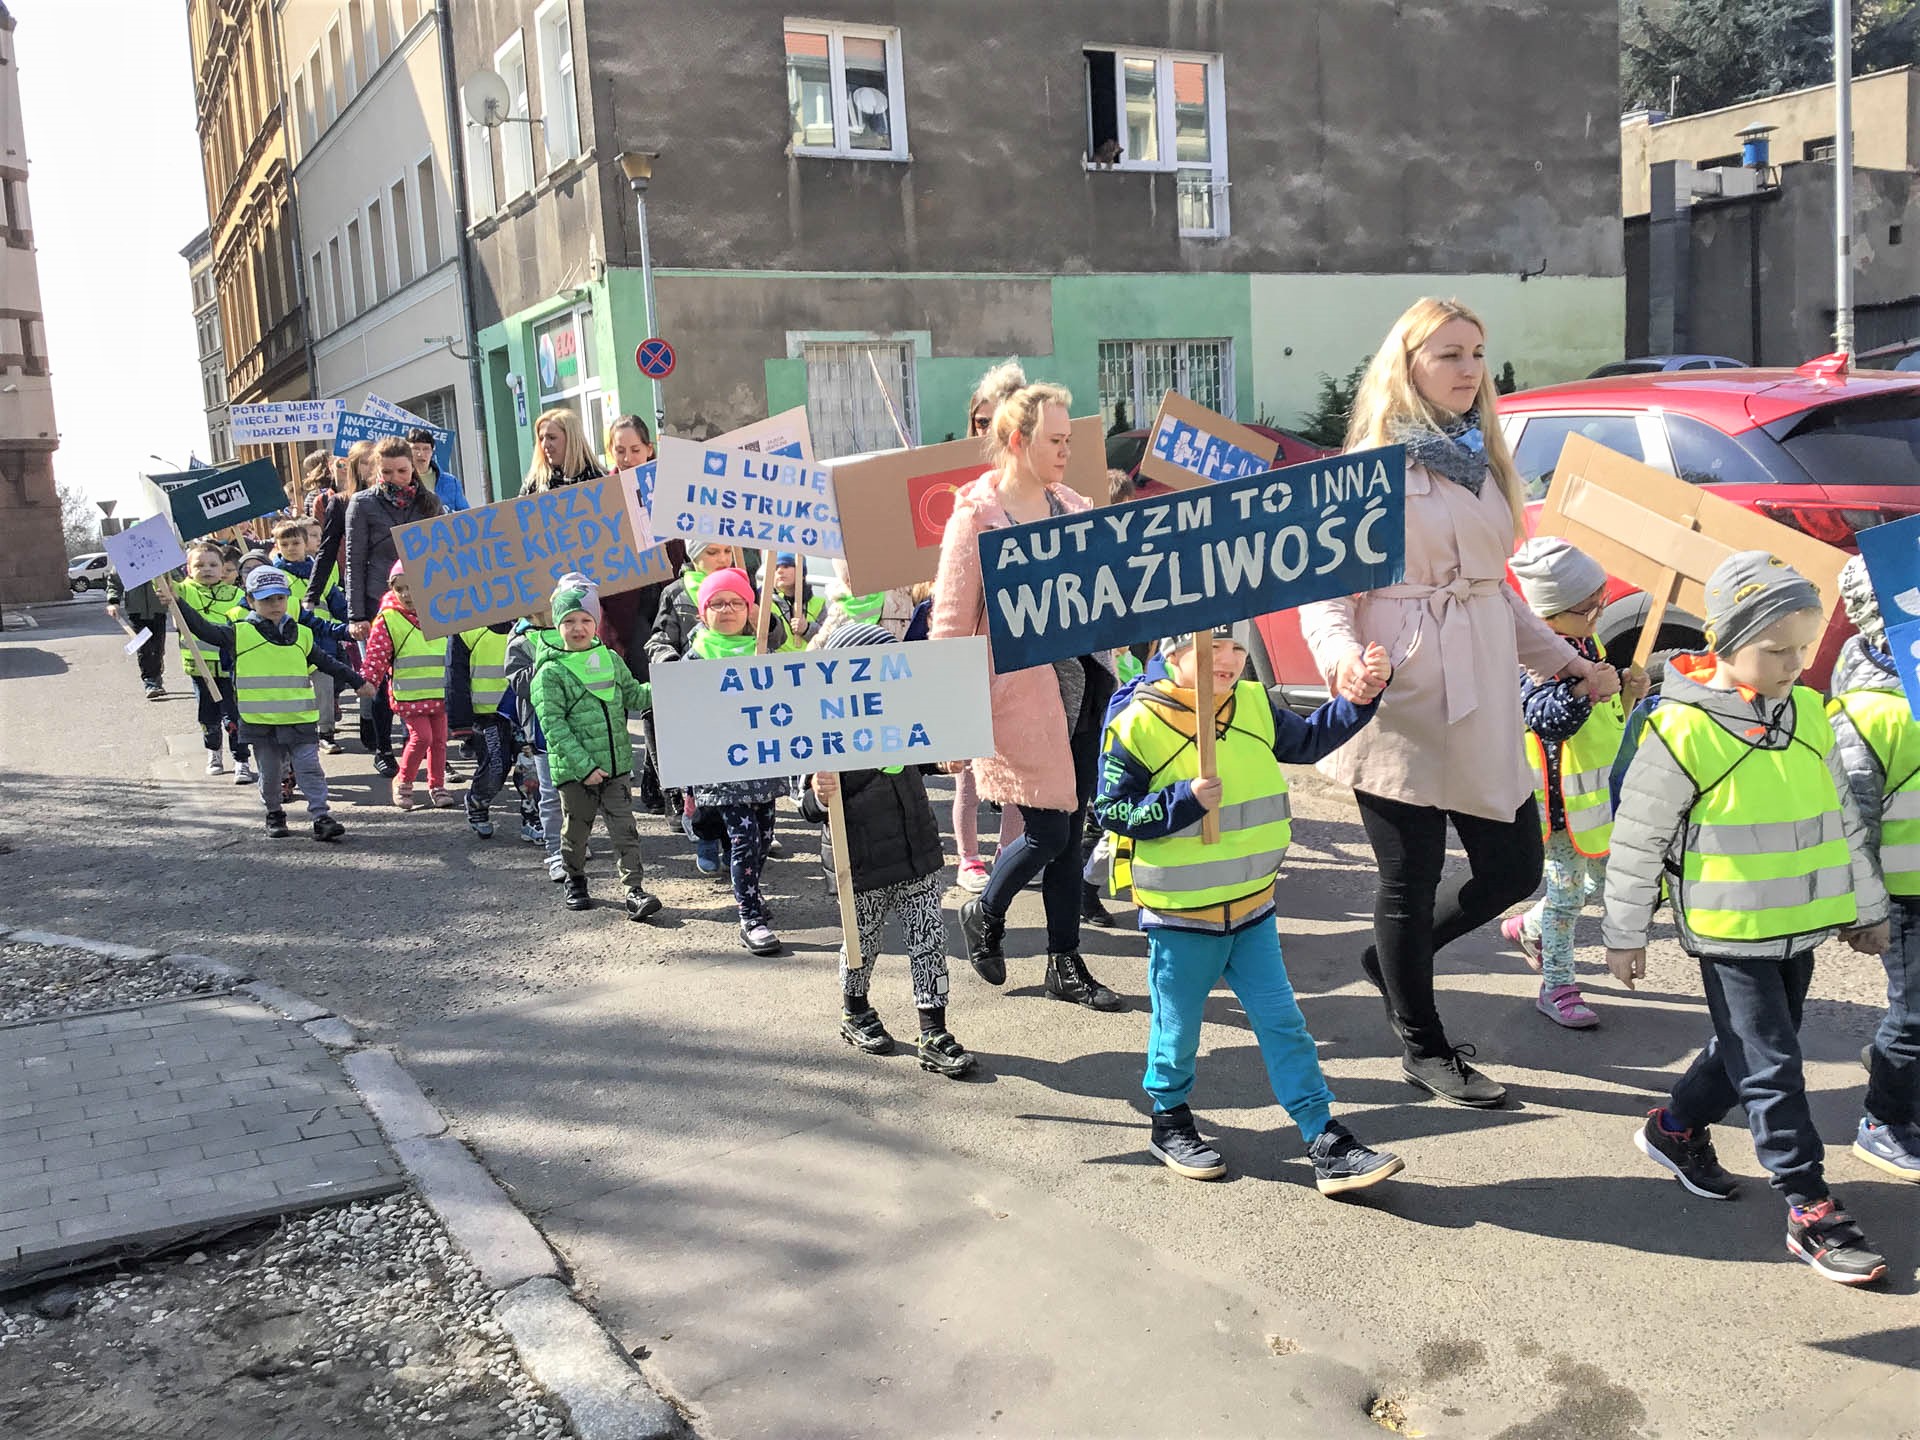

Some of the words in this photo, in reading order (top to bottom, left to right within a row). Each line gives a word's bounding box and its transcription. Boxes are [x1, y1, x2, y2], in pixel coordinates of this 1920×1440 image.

[342, 425, 360, 438] NA
[344, 415, 397, 432] INACZEJ
[743, 459, 828, 496] LUBIĘ
[515, 483, 605, 533] PRZY
[996, 496, 1212, 570] AUTYZM
[1231, 482, 1293, 520] TO
[1310, 459, 1391, 508] INNA
[423, 540, 517, 589] MNIE
[521, 510, 624, 563] KIEDY
[996, 494, 1388, 638] WRAŻLIWOŚĆ
[429, 568, 541, 625] CZUJĘ
[603, 544, 666, 582] SAM
[719, 652, 913, 692] AUTYZM
[741, 702, 793, 729] TO
[819, 692, 884, 720] NIE
[727, 722, 931, 767] CHOROBA
